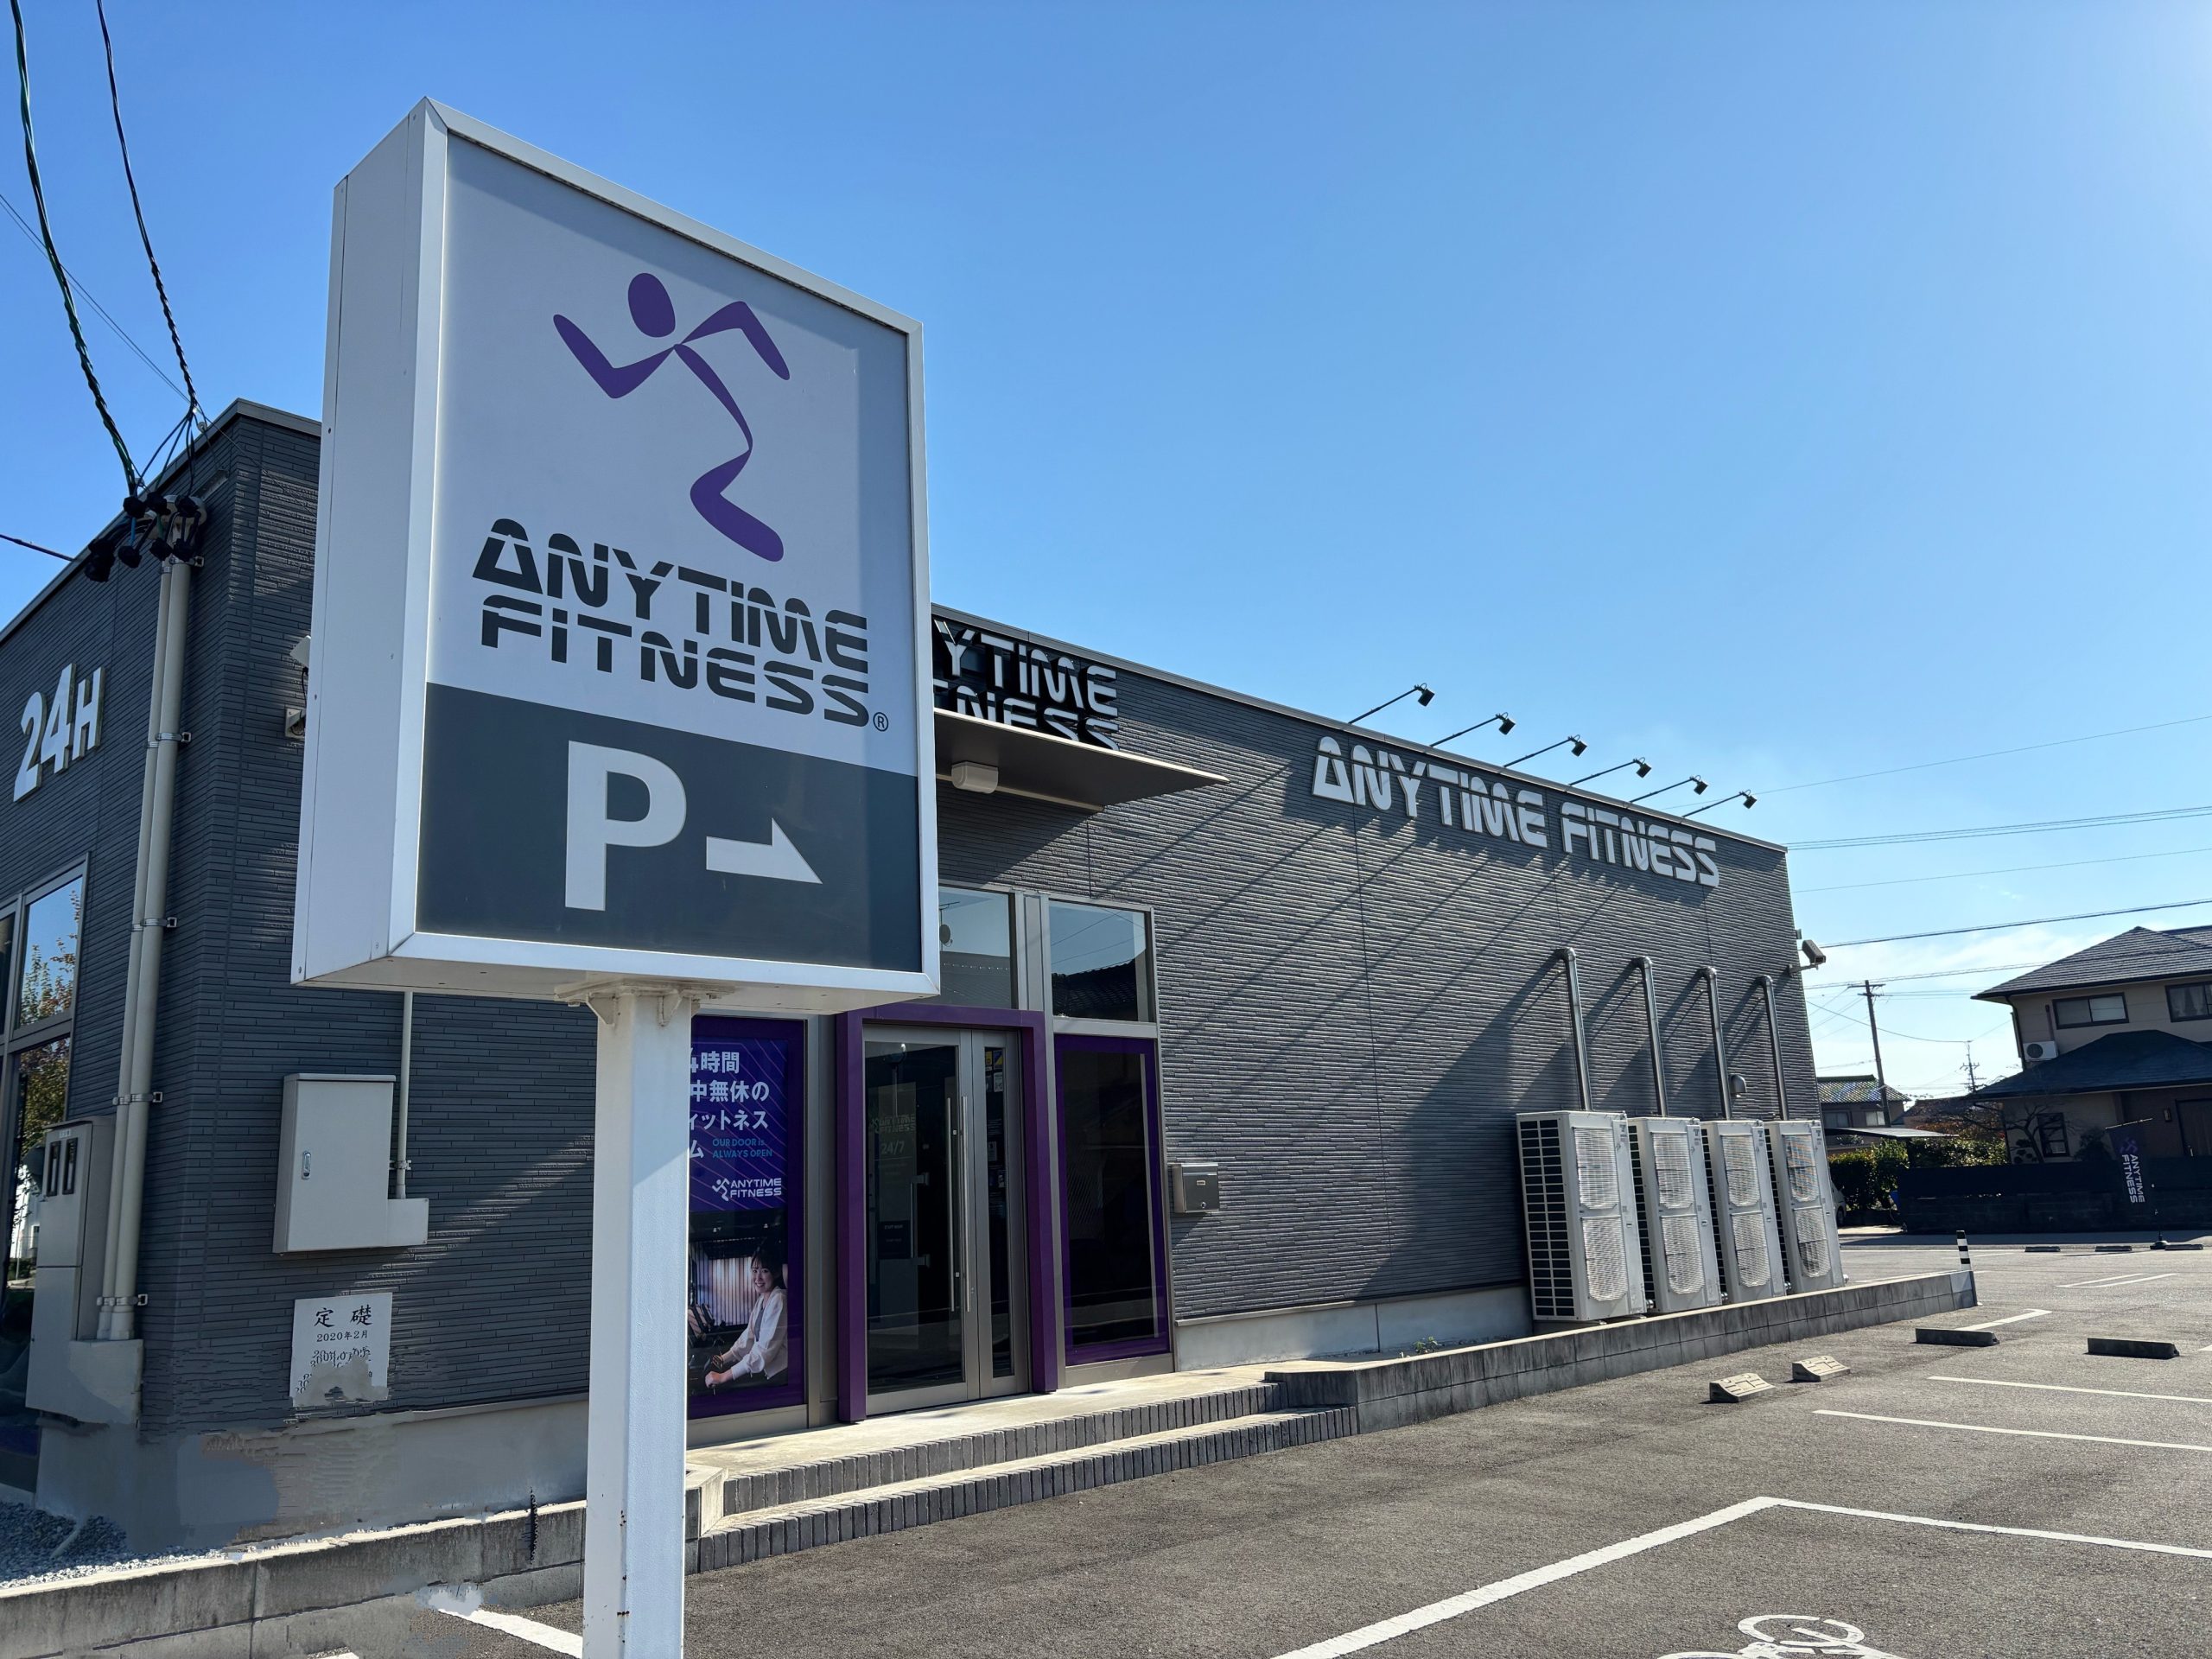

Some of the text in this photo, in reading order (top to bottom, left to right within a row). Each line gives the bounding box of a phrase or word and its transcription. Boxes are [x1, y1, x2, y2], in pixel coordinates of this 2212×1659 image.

[473, 518, 868, 674] ANYTIME
[13, 663, 104, 802] 24H
[1312, 736, 1720, 888] ANYTIME FITNESS
[565, 740, 687, 912] P
[690, 1079, 770, 1103] 中無休の
[712, 1138, 730, 1147] OUR
[732, 1138, 757, 1147] DOOR
[712, 1148, 773, 1159] ALWAYS OPEN
[880, 1140, 905, 1155] 24/7
[730, 1178, 782, 1189] ANYTIME
[2121, 1154, 2139, 1204] FITNESS
[2129, 1154, 2145, 1203] ANYTIME
[730, 1187, 782, 1198] FITNESS
[314, 1304, 373, 1328] 定礎
[316, 1330, 368, 1343] 2020年2月
